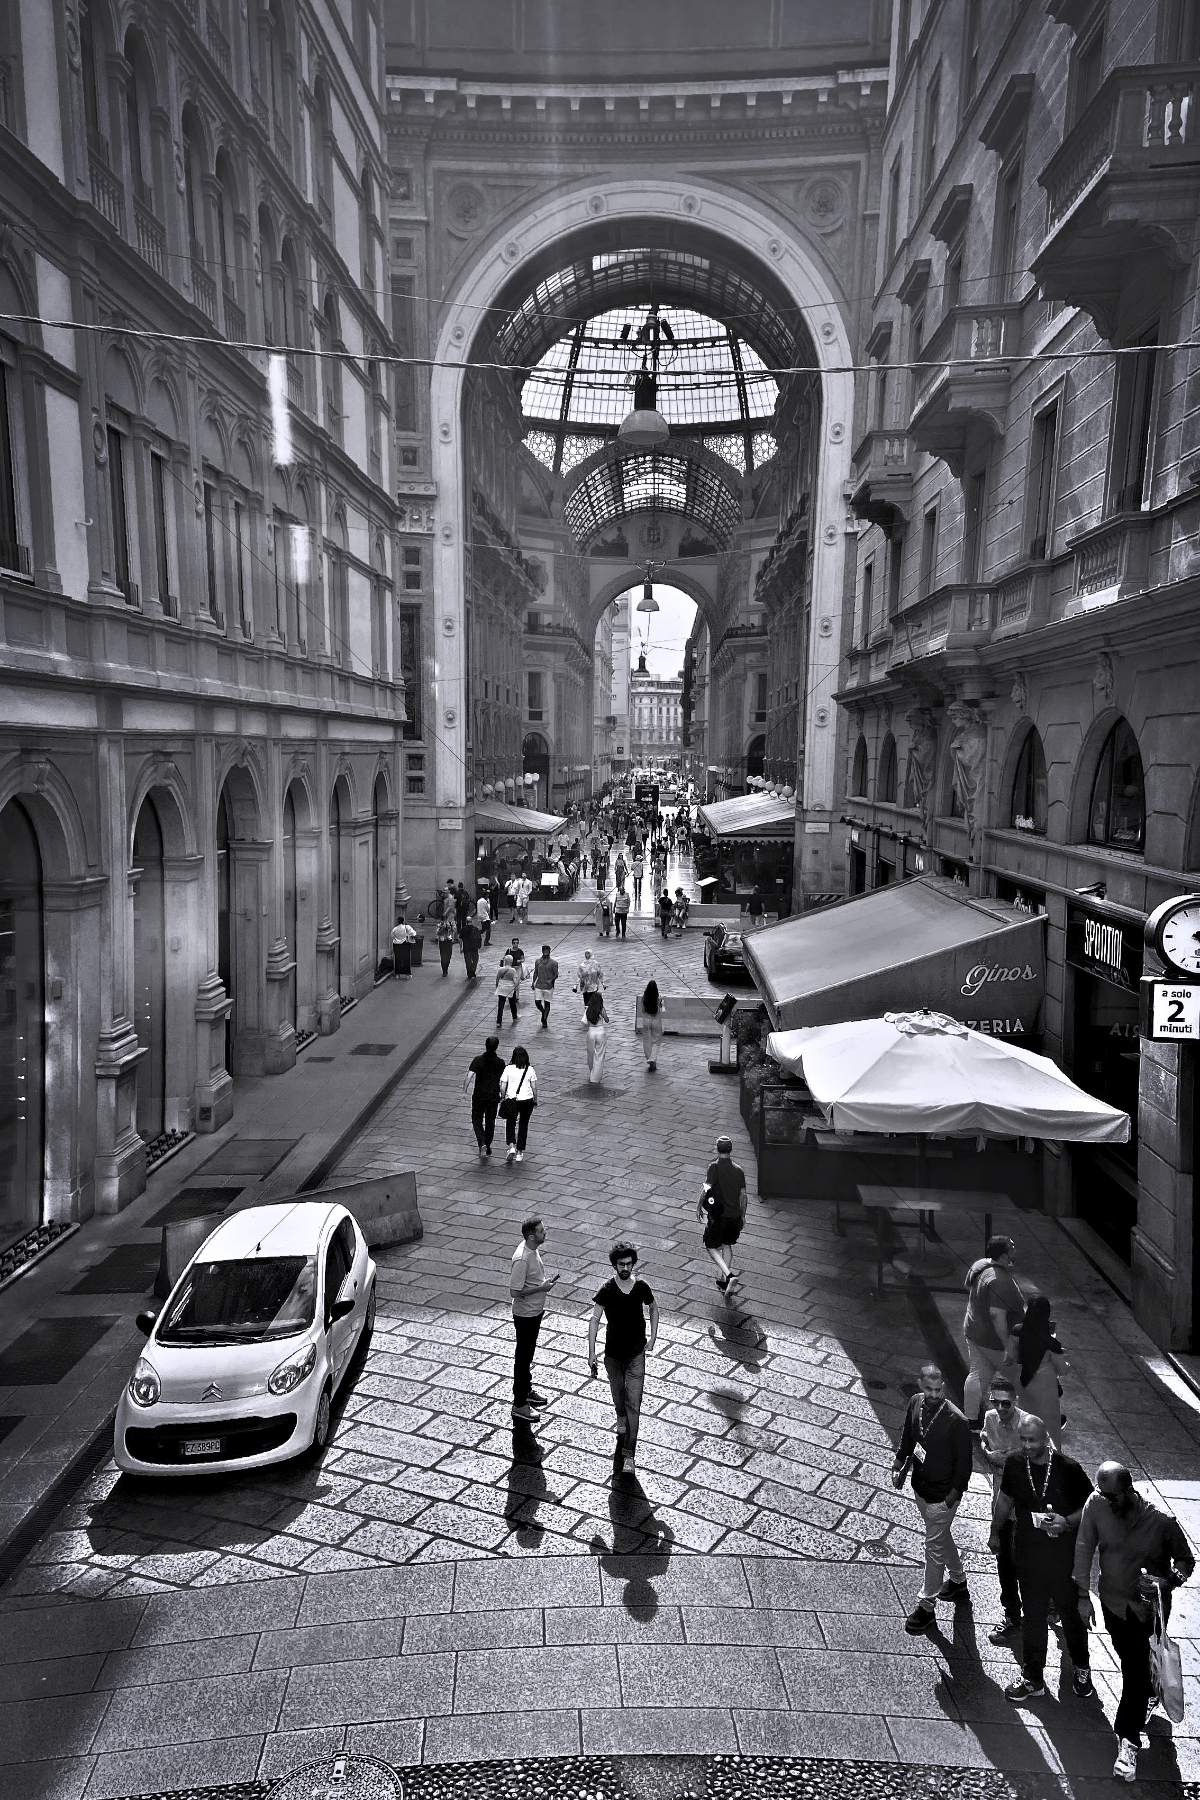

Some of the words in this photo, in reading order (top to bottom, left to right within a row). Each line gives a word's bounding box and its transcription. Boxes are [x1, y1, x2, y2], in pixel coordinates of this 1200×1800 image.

[1161, 990, 1168, 998] a
[1170, 989, 1192, 998] solo
[1167, 1000, 1185, 1023] 2
[1159, 1024, 1193, 1034] minuti
